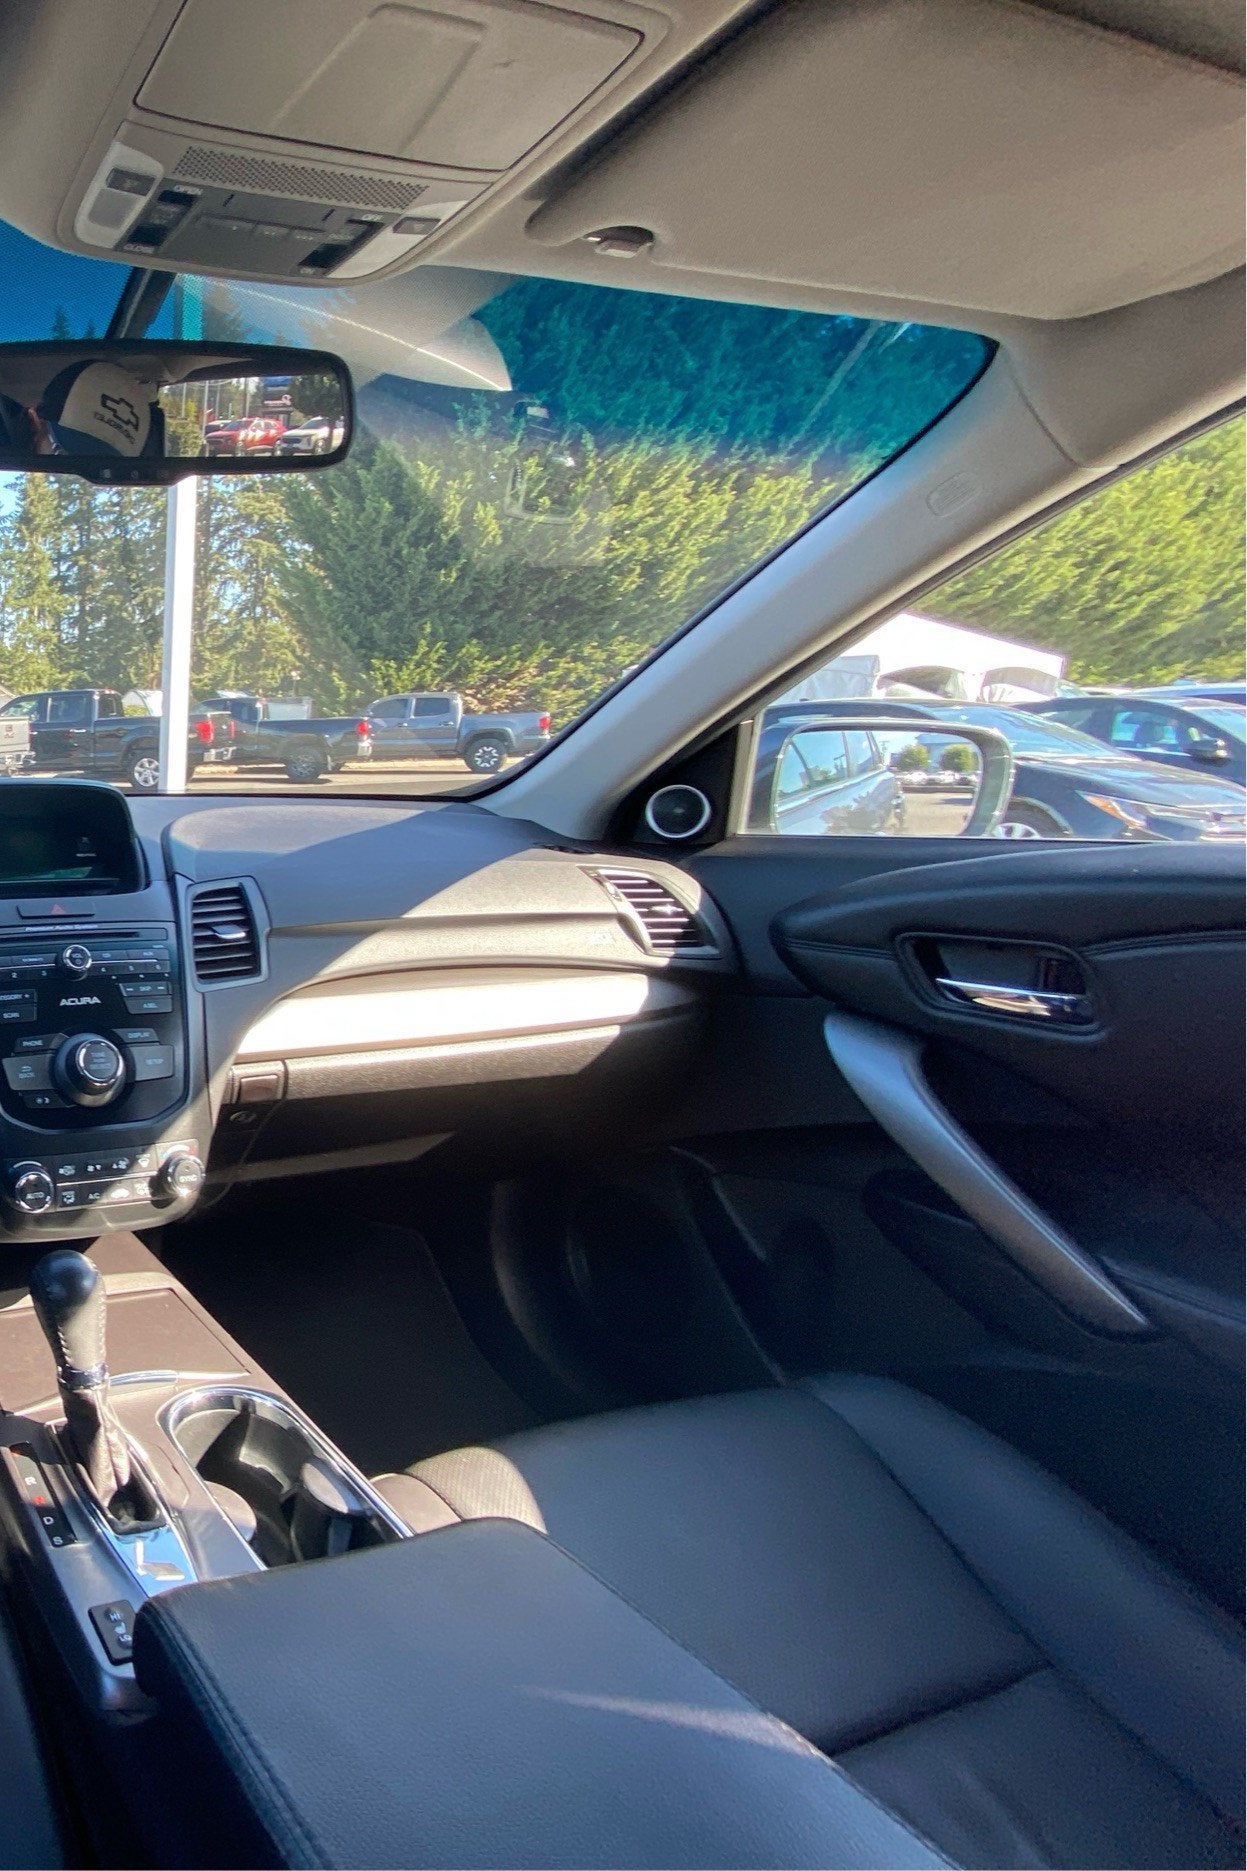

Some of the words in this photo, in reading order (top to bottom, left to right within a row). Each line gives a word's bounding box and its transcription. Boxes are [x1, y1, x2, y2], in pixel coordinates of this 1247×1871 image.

[59, 996, 102, 1006] ACURA
[22, 1039, 43, 1047] PHONE
[179, 1174, 198, 1183] SYNC
[42, 1516, 54, 1525] D
[52, 1536, 63, 1545] S
[108, 1612, 121, 1621] HI
[118, 1633, 133, 1642] LO
